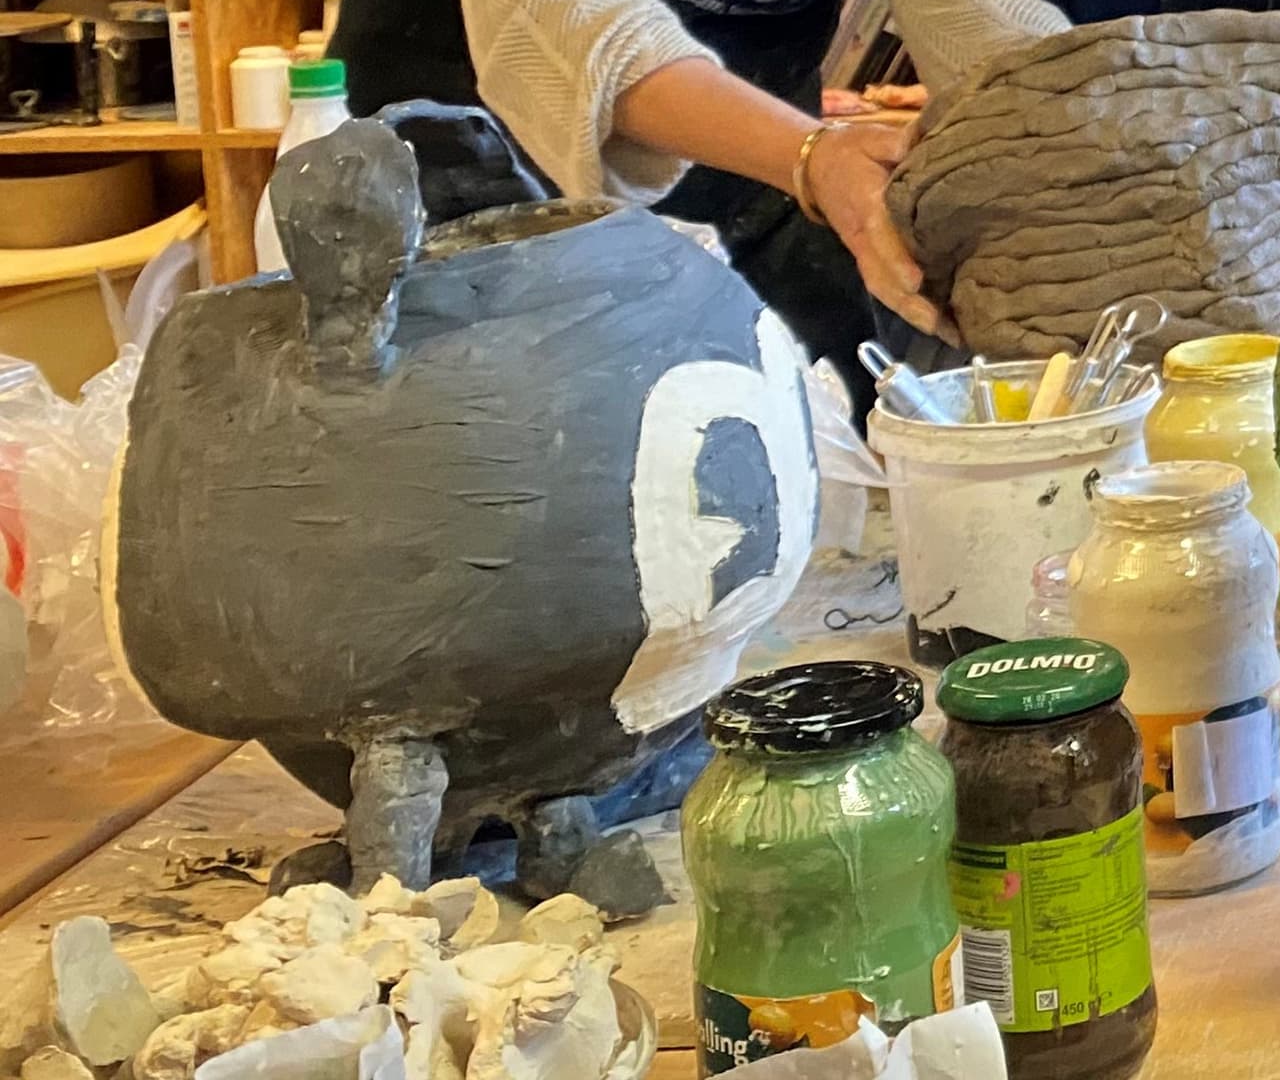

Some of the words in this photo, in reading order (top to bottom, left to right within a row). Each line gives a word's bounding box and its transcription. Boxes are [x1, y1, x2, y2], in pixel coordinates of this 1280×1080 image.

[966, 653, 1096, 679] DOLMIO
[1062, 1002, 1085, 1016] 450
[700, 1018, 748, 1067] lling
